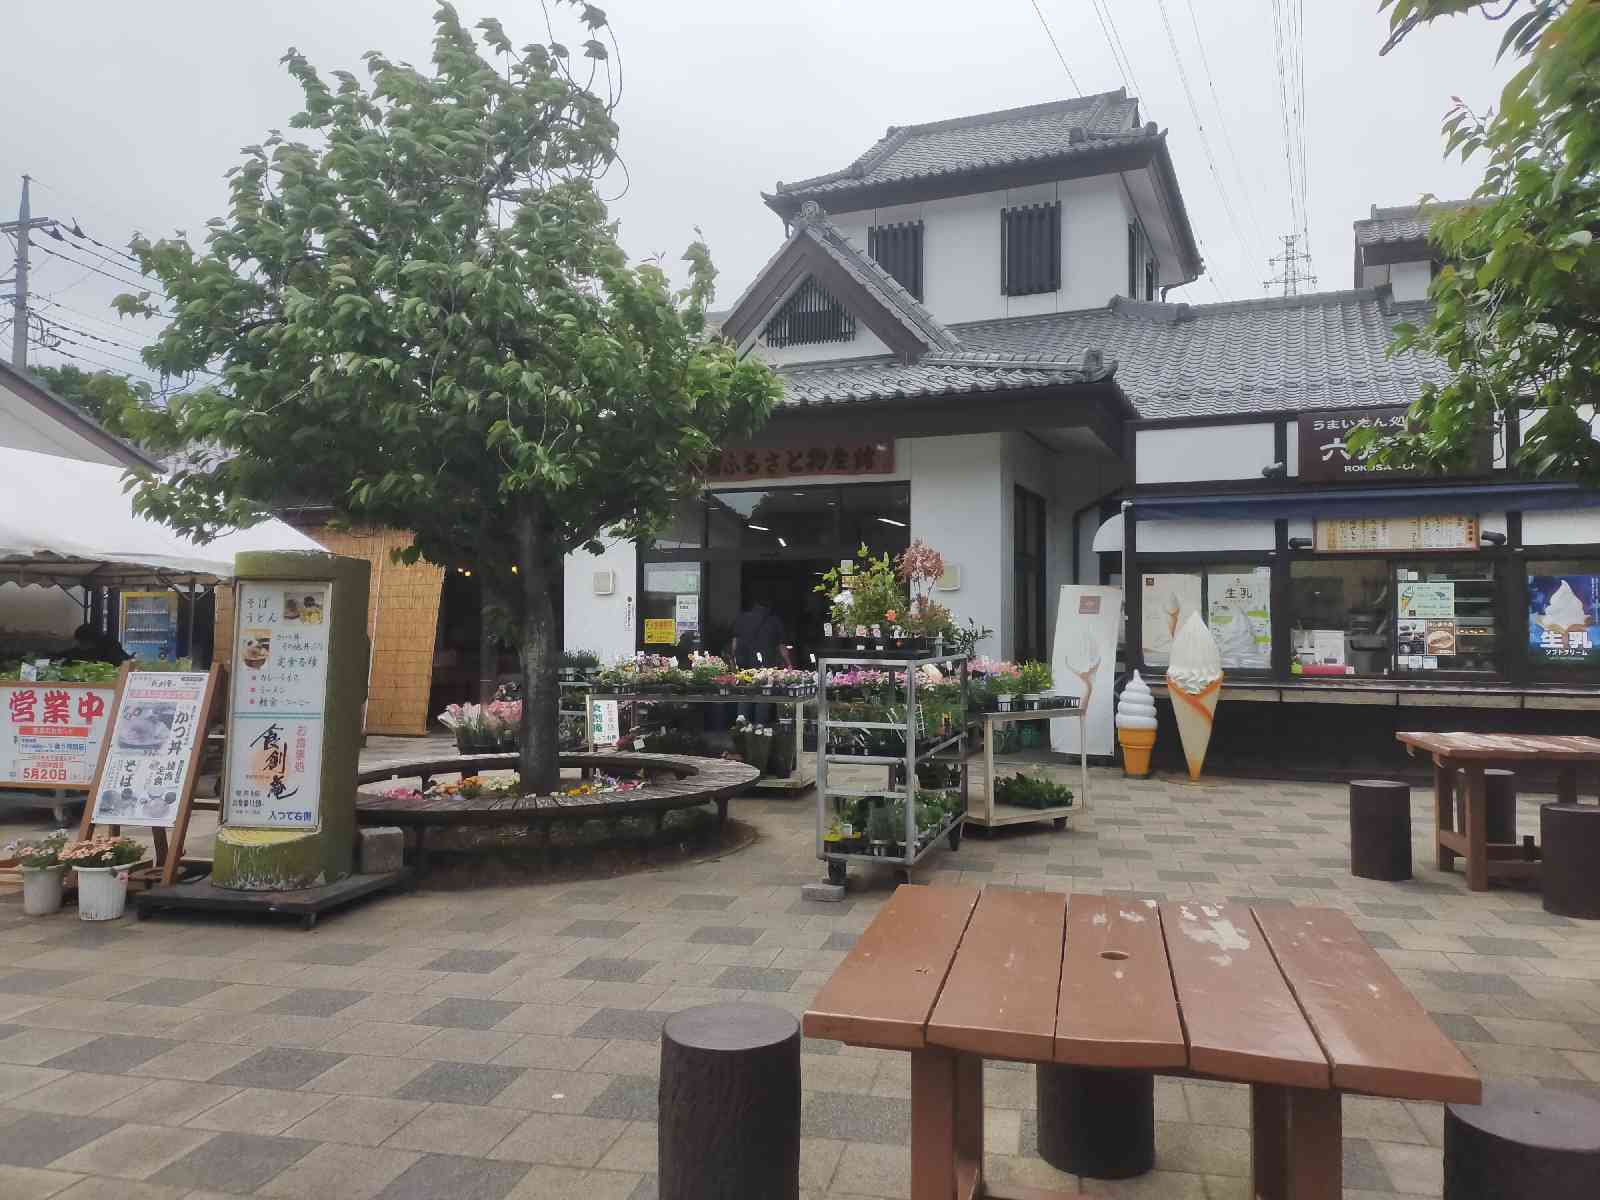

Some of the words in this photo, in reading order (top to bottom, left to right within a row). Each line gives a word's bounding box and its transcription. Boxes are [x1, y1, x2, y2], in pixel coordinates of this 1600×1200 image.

[1224, 586, 1253, 599] 生乳
[246, 612, 278, 624] うどん
[1539, 631, 1593, 648] 生乳
[260, 685, 287, 694] ラーメン
[9, 689, 105, 725] 営業中
[167, 710, 189, 756] かつ丼
[249, 723, 299, 800] 食創庵
[23, 768, 67, 780] 5月20日
[119, 759, 137, 787] そば
[268, 810, 313, 822] 入って右側
